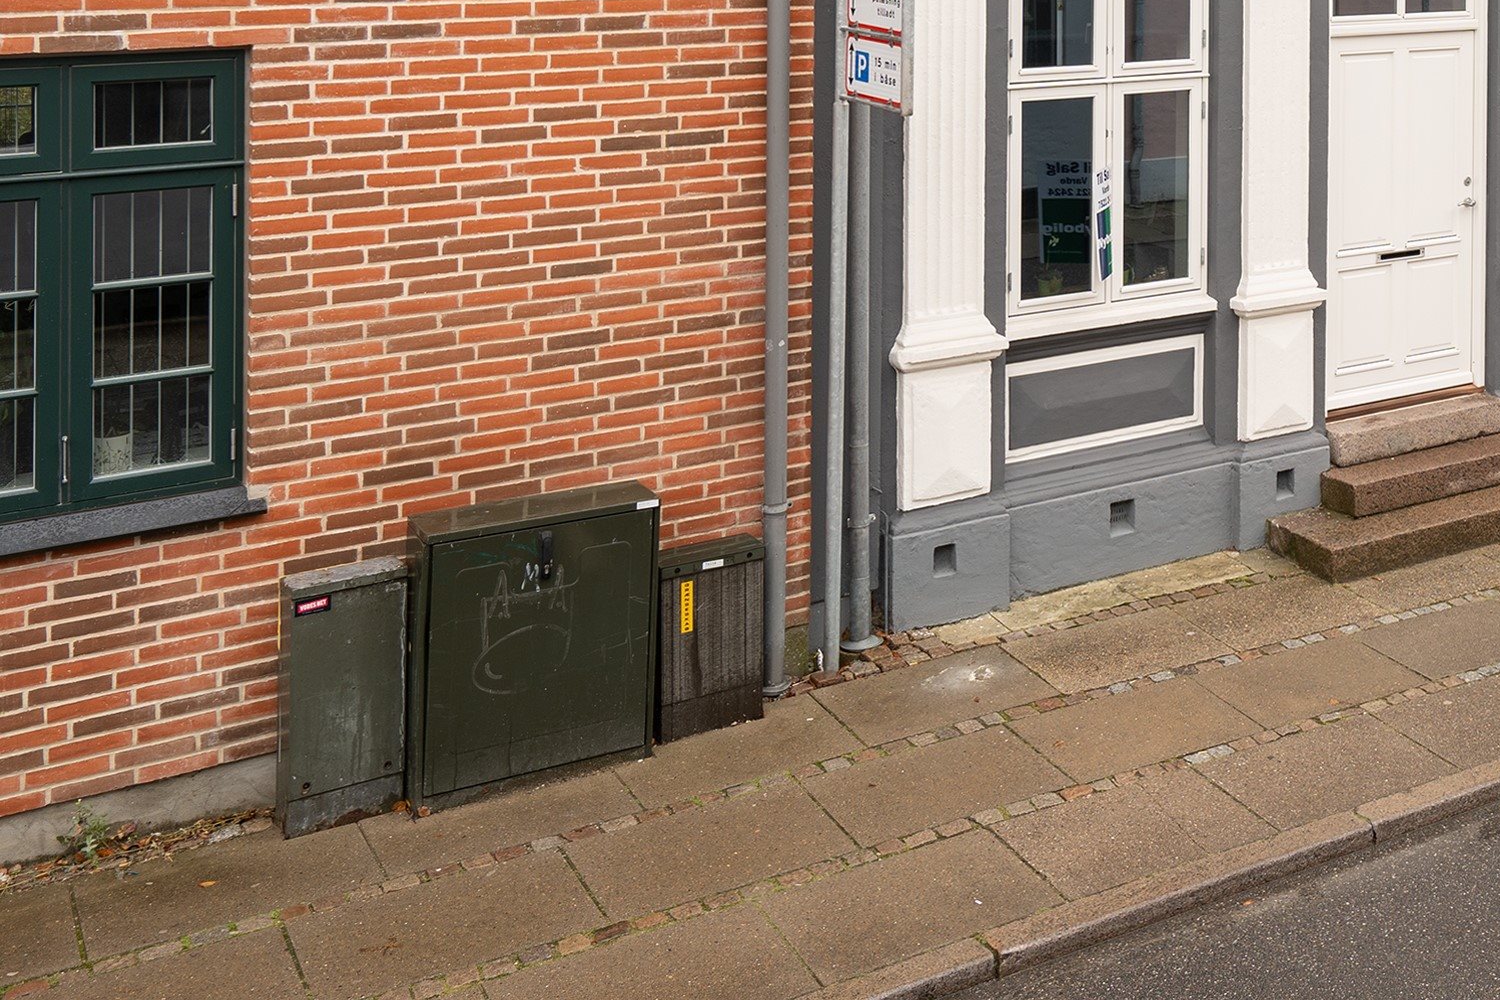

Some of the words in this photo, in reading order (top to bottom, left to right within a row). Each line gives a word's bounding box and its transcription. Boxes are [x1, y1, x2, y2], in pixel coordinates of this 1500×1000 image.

[877, 8, 895, 18] tilladt
[858, 54, 867, 78] P
[874, 57, 882, 68] 15
[880, 73, 896, 87] båse
